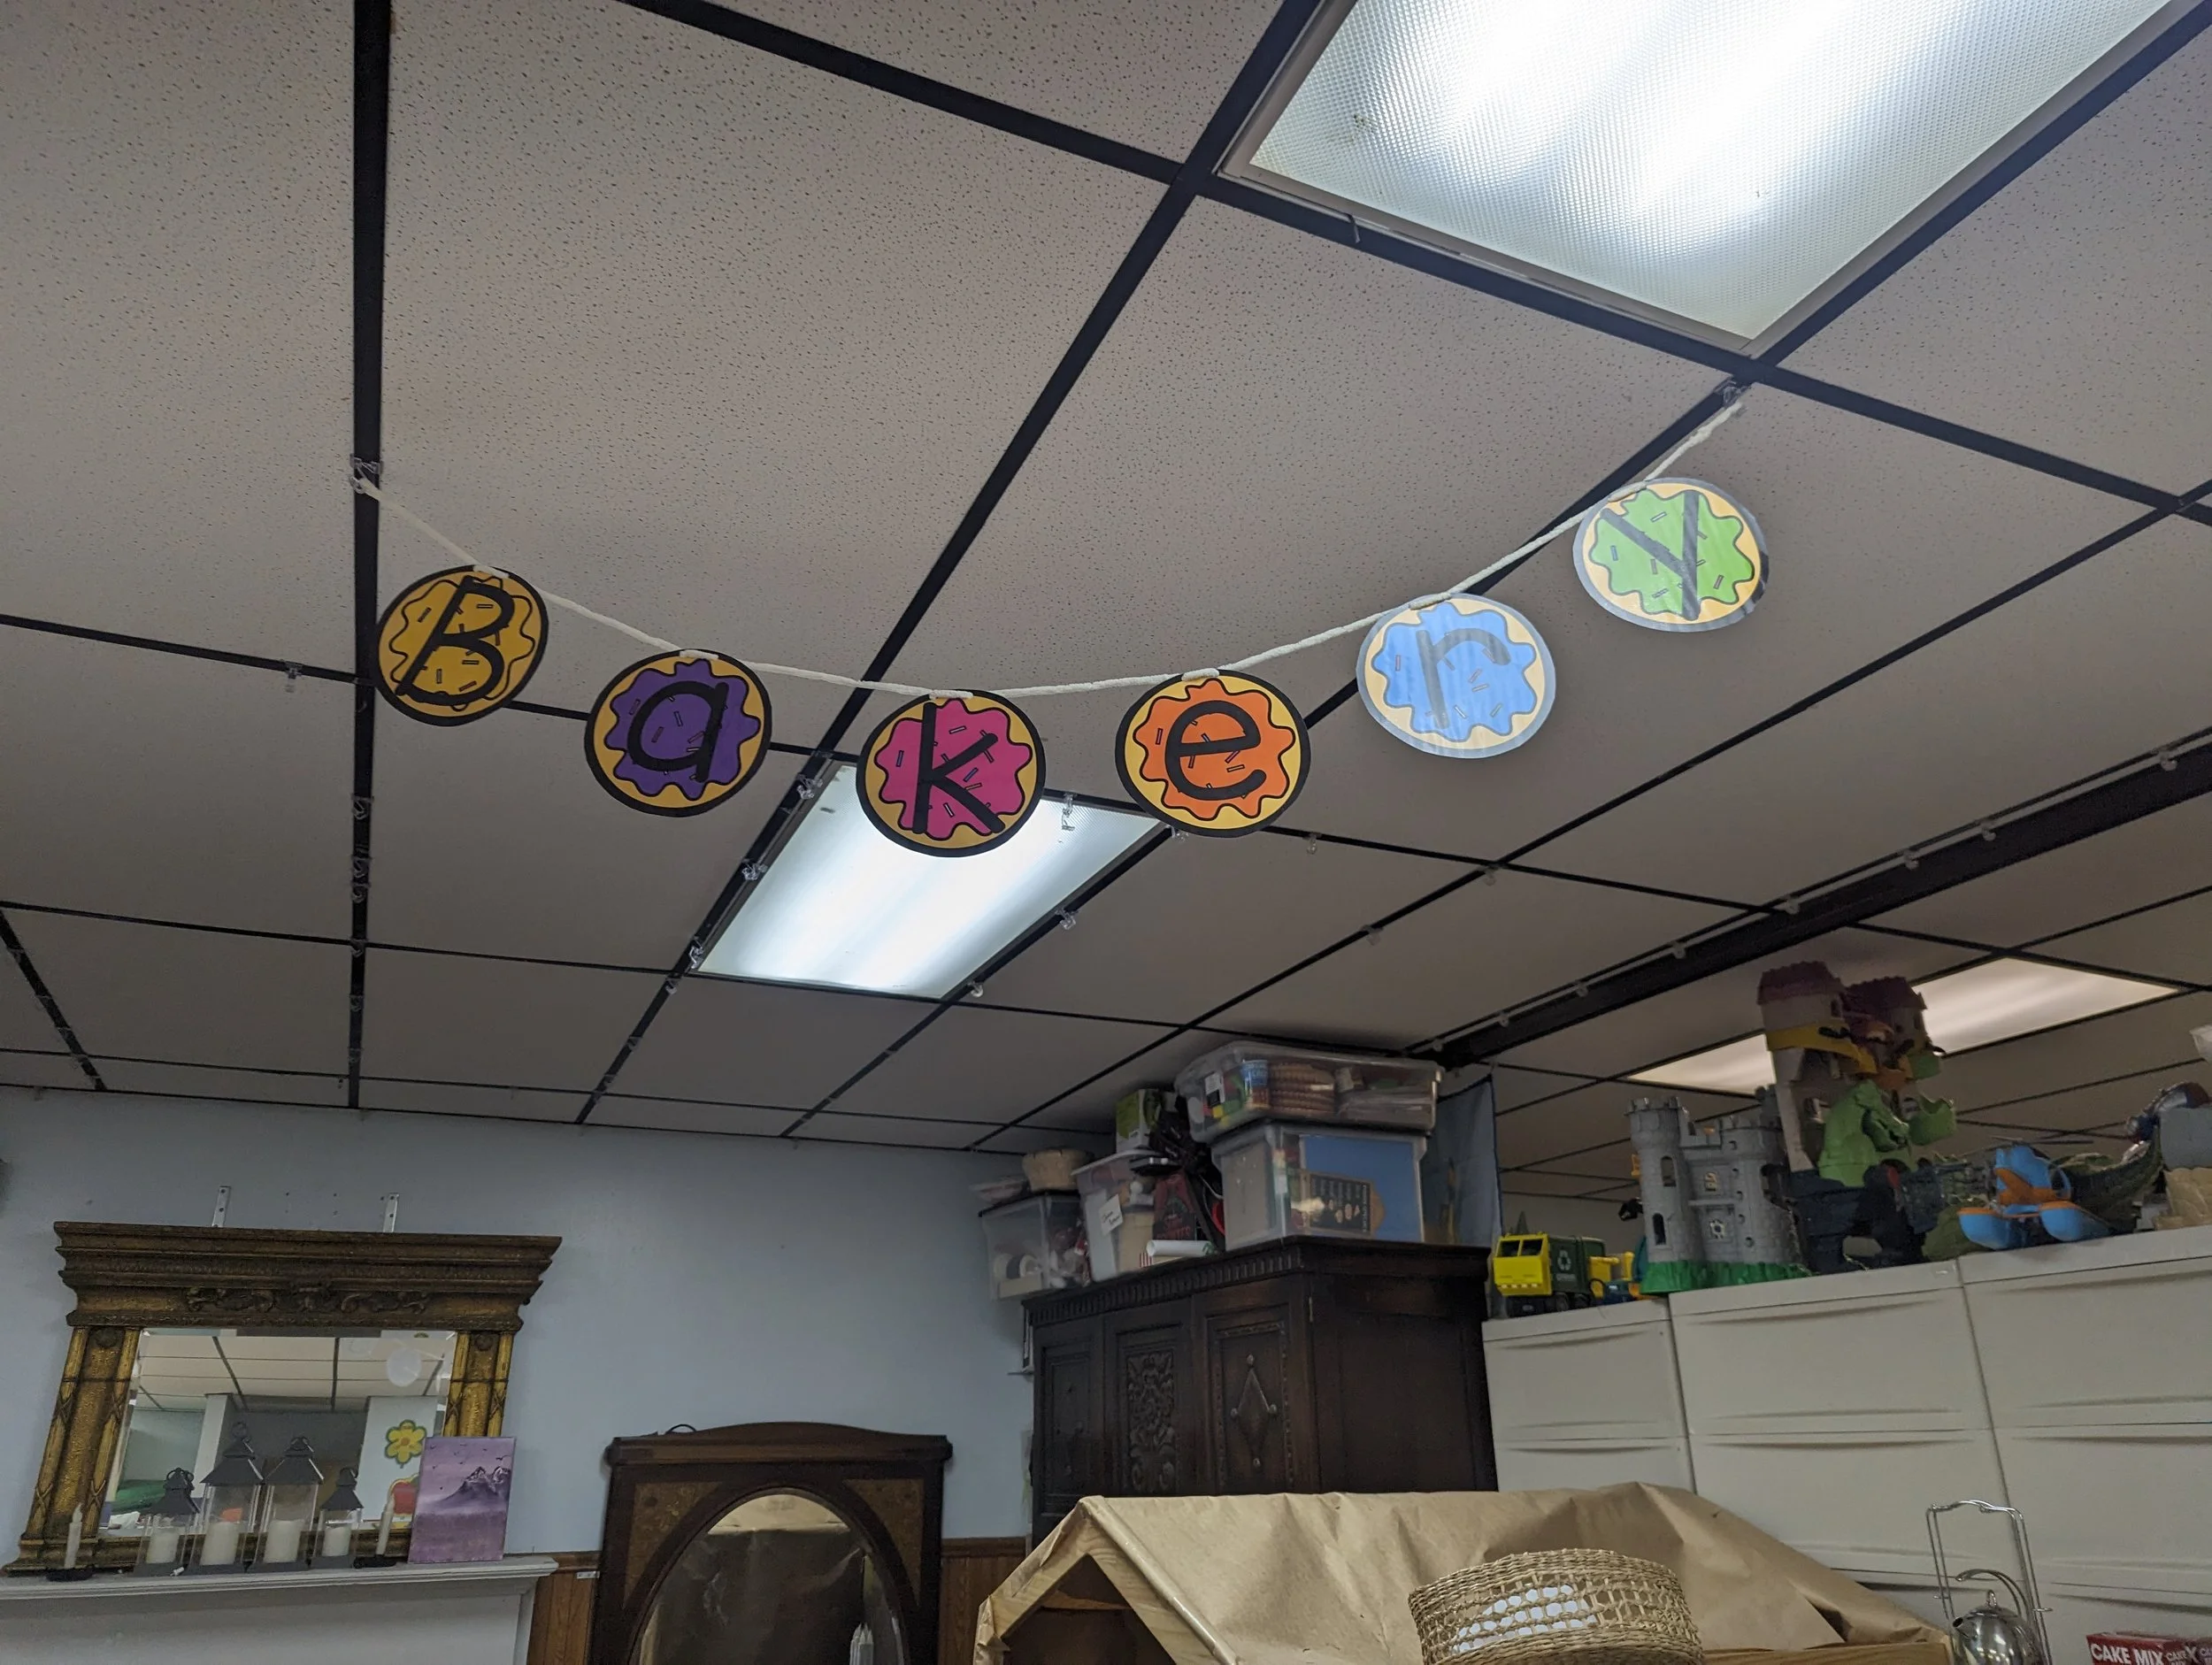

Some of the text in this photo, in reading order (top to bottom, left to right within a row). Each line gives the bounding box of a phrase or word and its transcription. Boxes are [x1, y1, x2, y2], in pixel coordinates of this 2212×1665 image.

[397, 488, 1700, 834] Bakery
[2090, 1643, 2164, 1665] CAKE MIX
